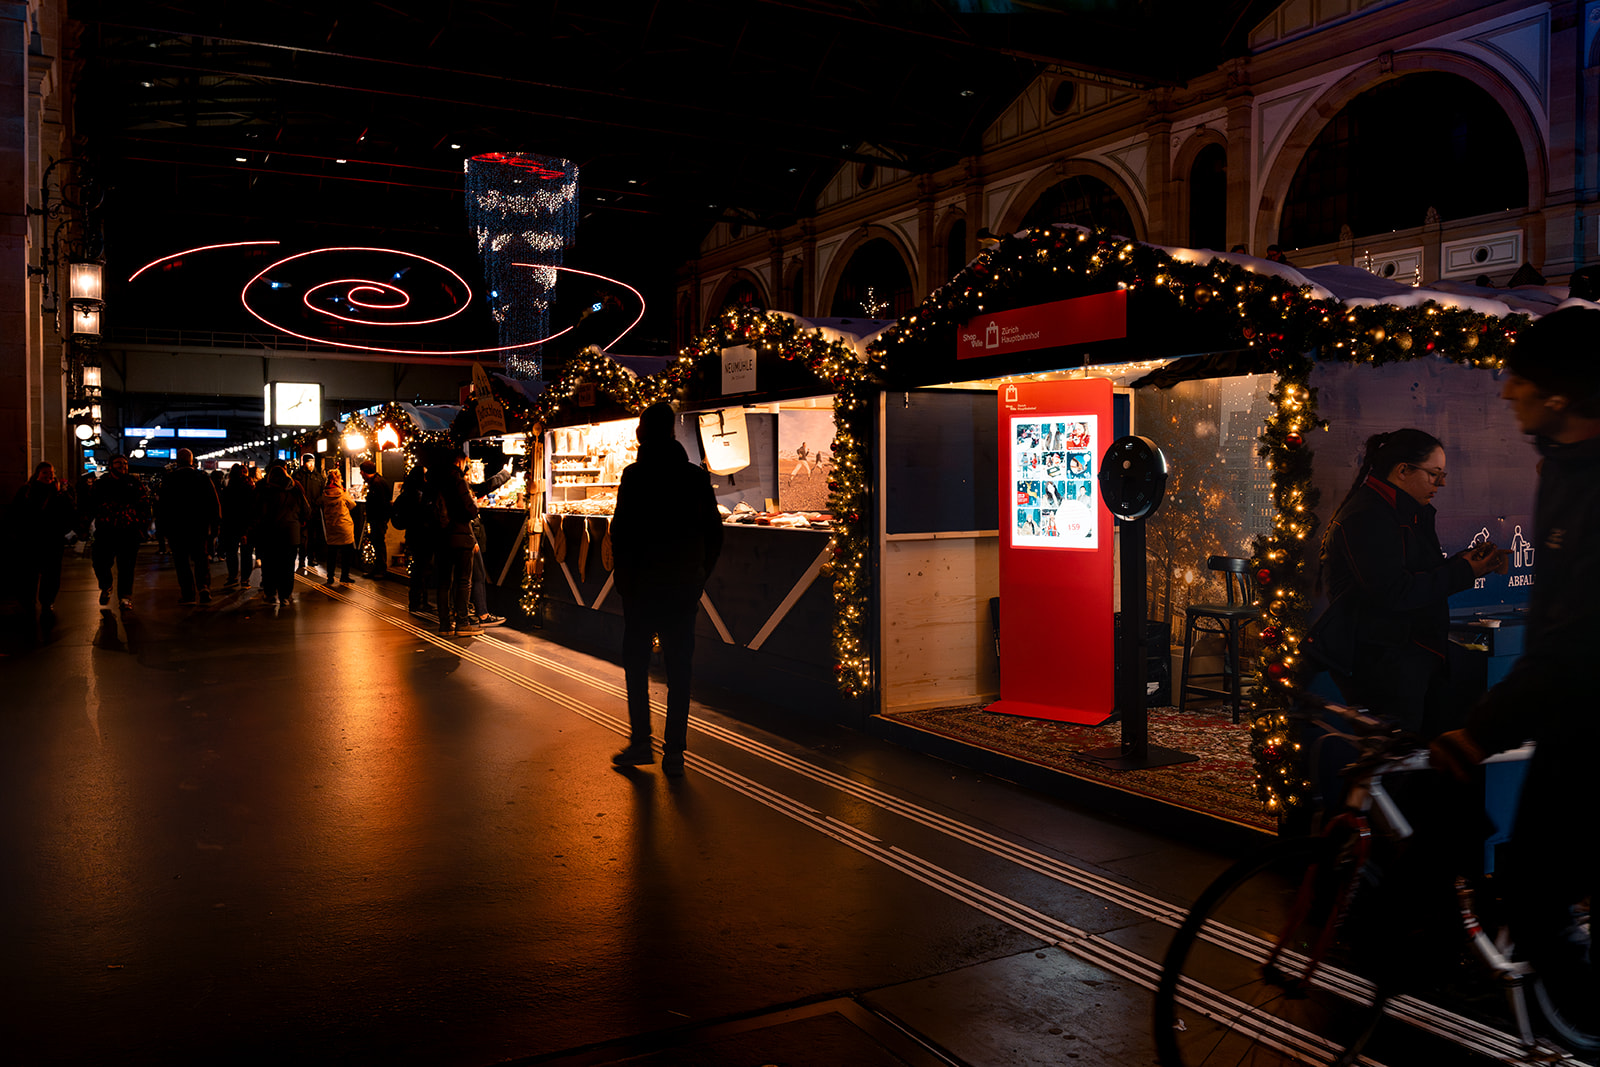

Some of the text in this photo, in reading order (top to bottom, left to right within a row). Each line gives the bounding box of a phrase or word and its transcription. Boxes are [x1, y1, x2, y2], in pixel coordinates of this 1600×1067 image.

[1002, 326, 1019, 335] Zürich
[963, 334, 976, 342] Shop
[1001, 331, 1040, 343] Hauptbahnhof
